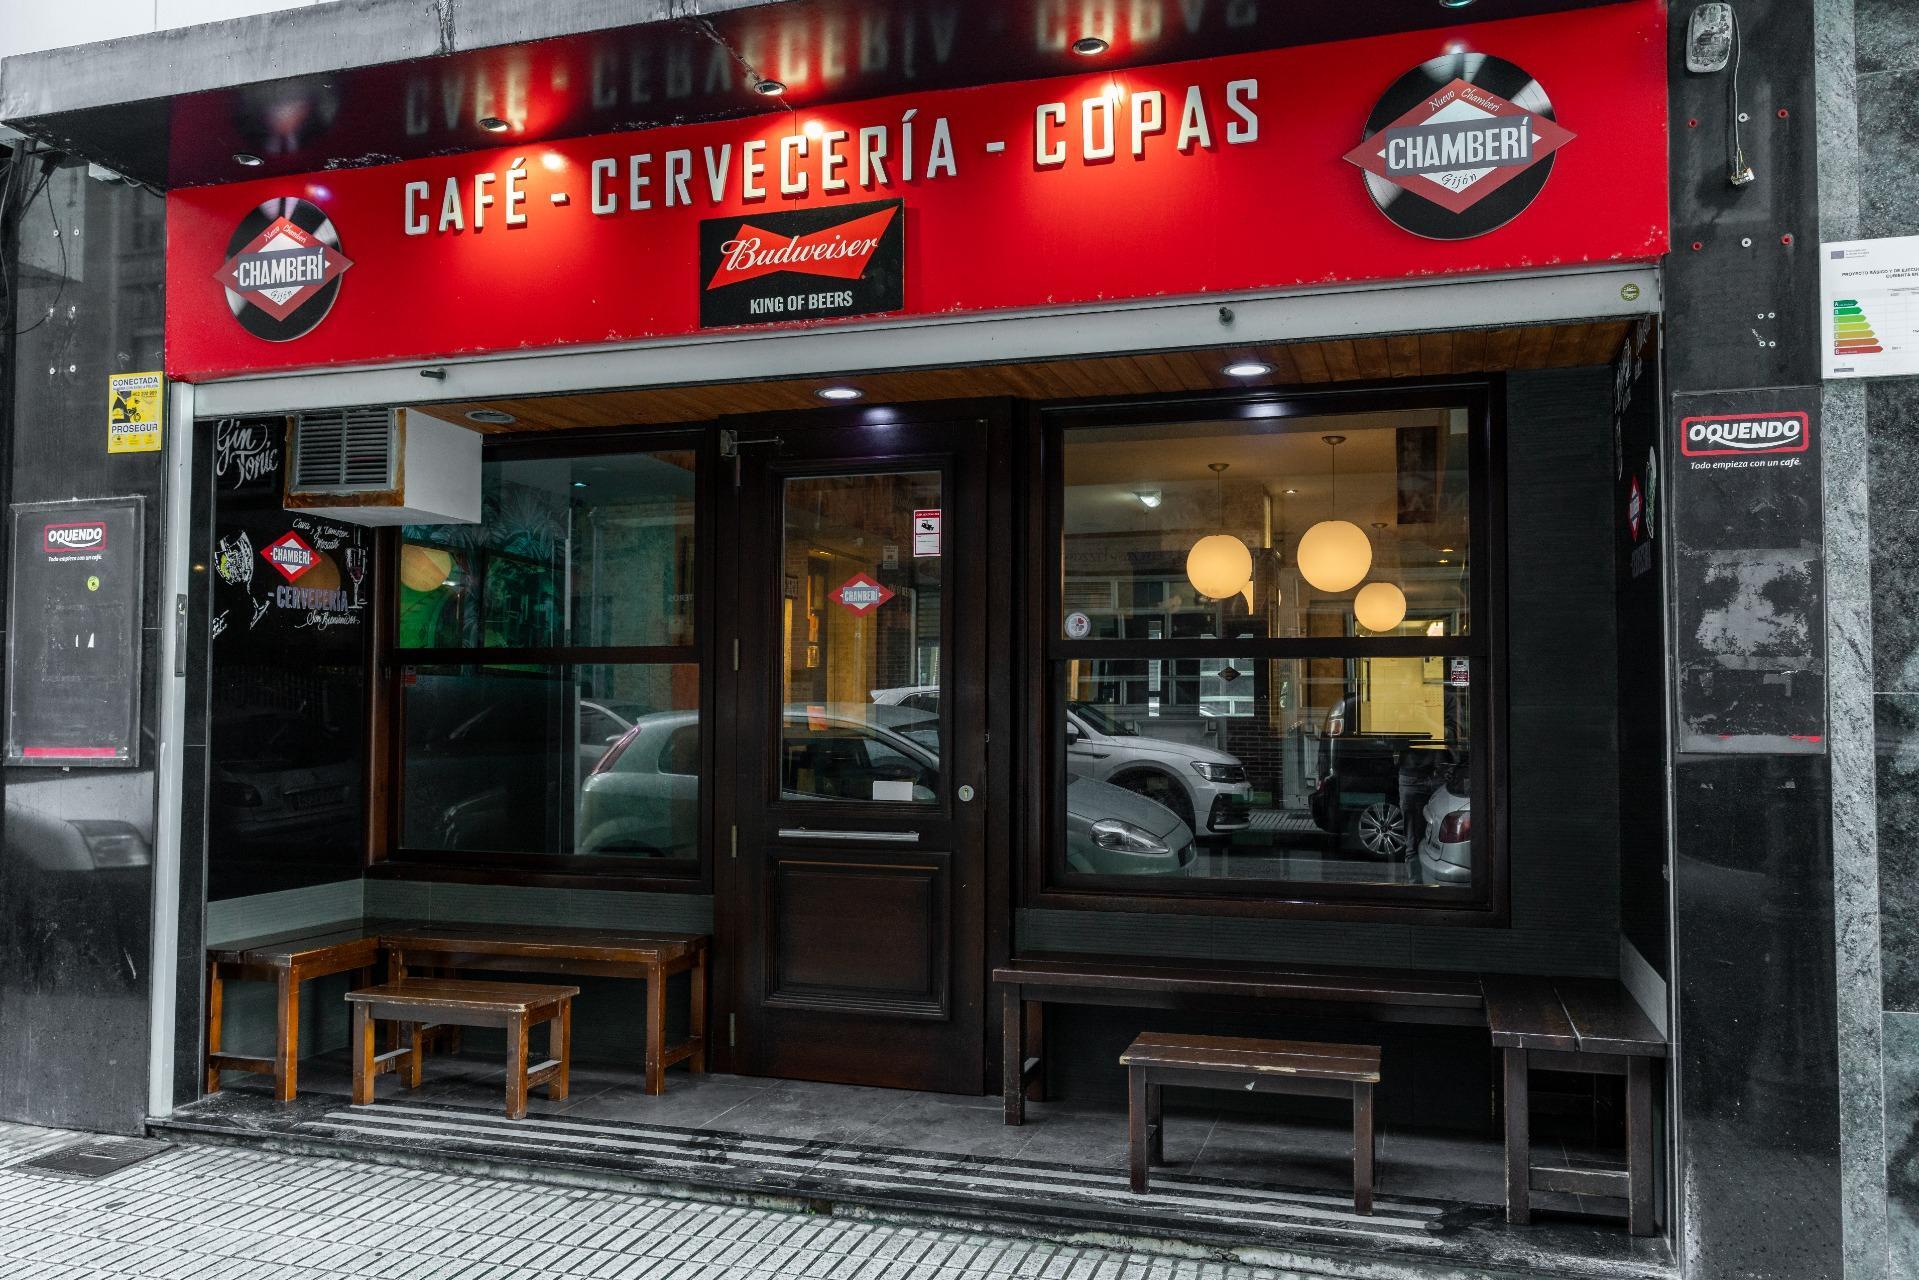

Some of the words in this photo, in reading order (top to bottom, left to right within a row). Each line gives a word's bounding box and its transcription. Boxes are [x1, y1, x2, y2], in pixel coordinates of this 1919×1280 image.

[1429, 90, 1455, 111] Nuevo
[1388, 116, 1529, 170] CHAMBERÍ
[404, 157, 528, 236] CAFÉ
[591, 109, 957, 216] CERVECERÍA
[1036, 78, 1259, 167] COPAS
[1441, 173, 1477, 188] Gijón
[720, 234, 879, 272] Budweiser
[239, 247, 324, 287] CHAMBERÍ
[750, 296, 784, 315] KING
[787, 294, 806, 312] OF
[808, 290, 853, 311] BEERS
[112, 376, 159, 387] CONECTADA
[111, 423, 158, 434] PROSEGUR
[1689, 420, 1801, 449] OQUENDO
[216, 418, 256, 476] Gin
[229, 423, 279, 490] Tonic
[1690, 461, 1711, 470] Todo
[1712, 460, 1748, 470] empieza
[1750, 460, 1765, 468] con
[48, 527, 103, 548] OQUENDO
[272, 547, 310, 565] CHAMBERÍ
[276, 585, 348, 612] CERVECERÍA
